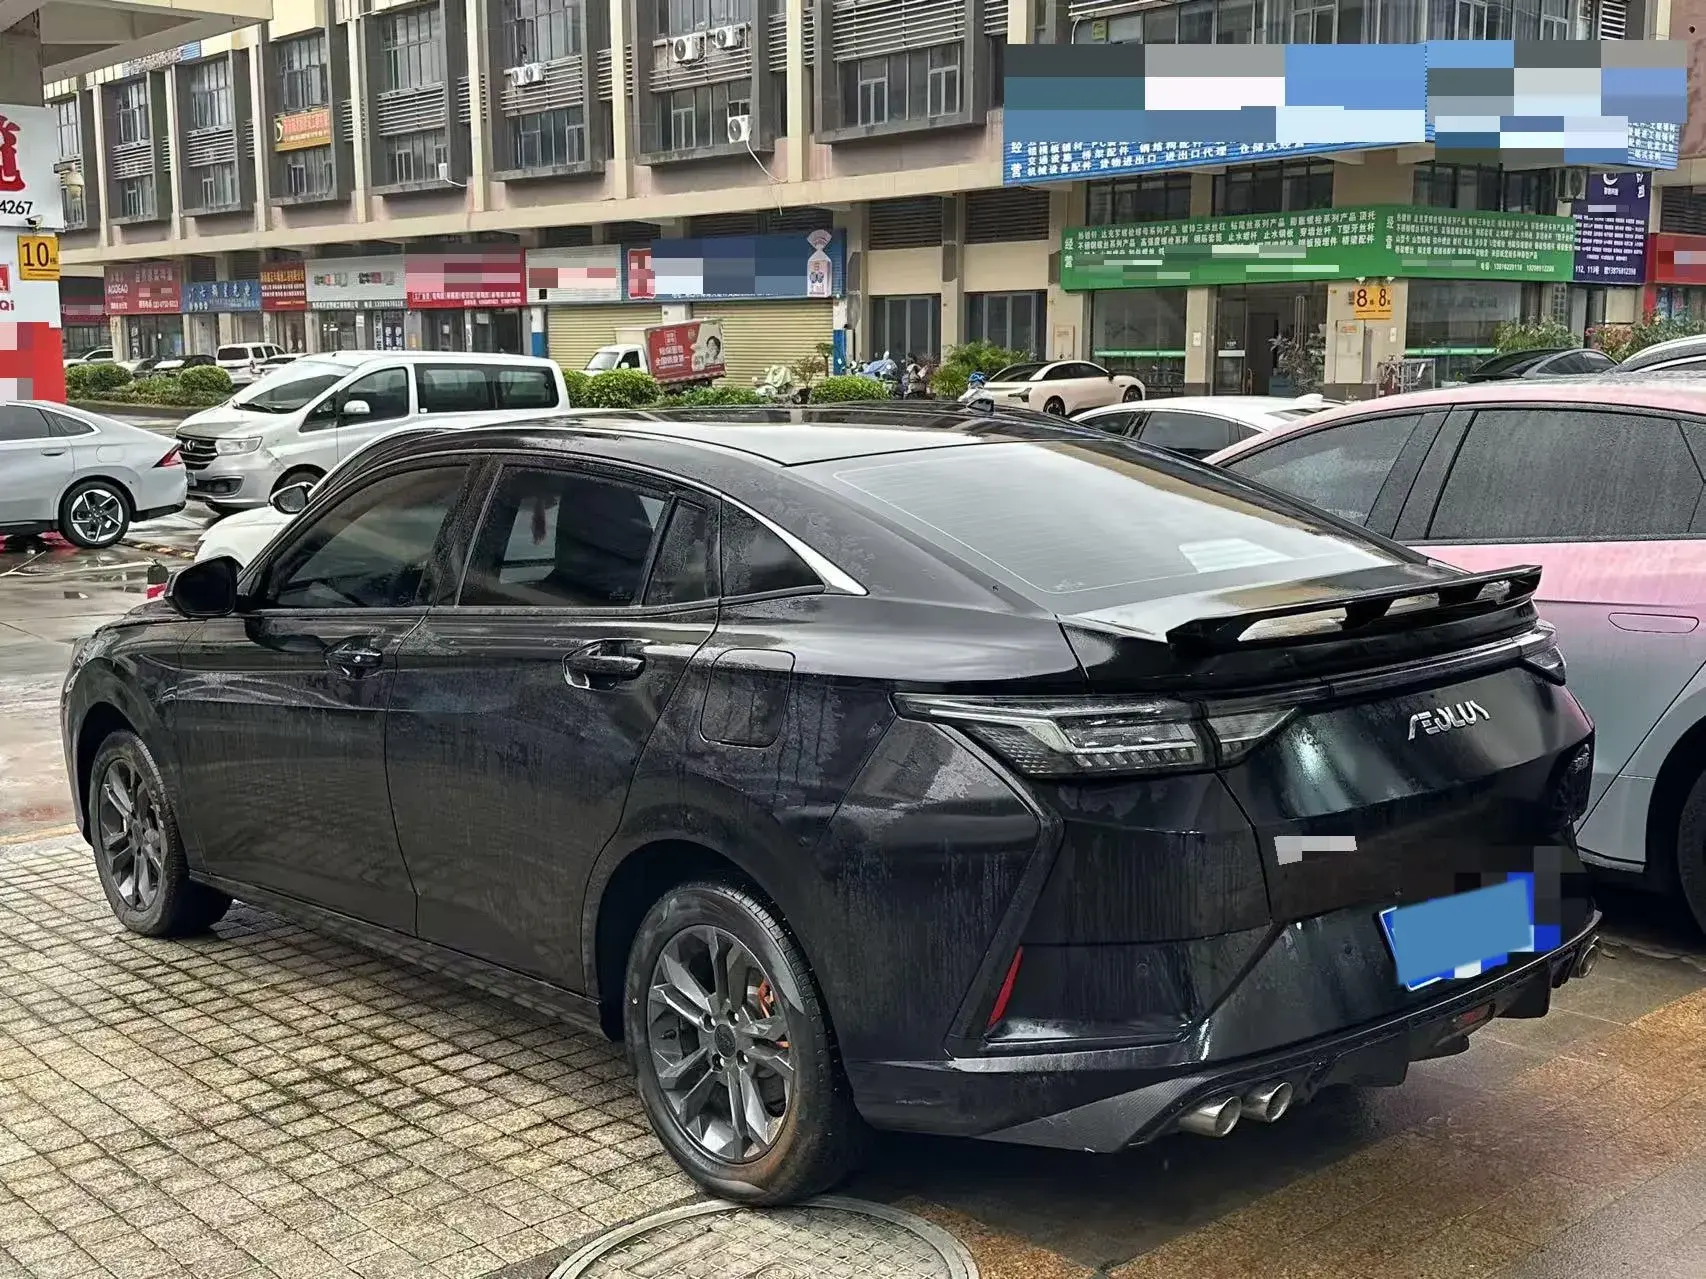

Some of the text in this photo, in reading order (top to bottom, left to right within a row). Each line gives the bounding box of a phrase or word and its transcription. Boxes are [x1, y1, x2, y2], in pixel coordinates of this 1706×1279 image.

[1100, 154, 1156, 168] 货物进出口
[0, 200, 33, 215] 4267
[22, 242, 49, 267] 10
